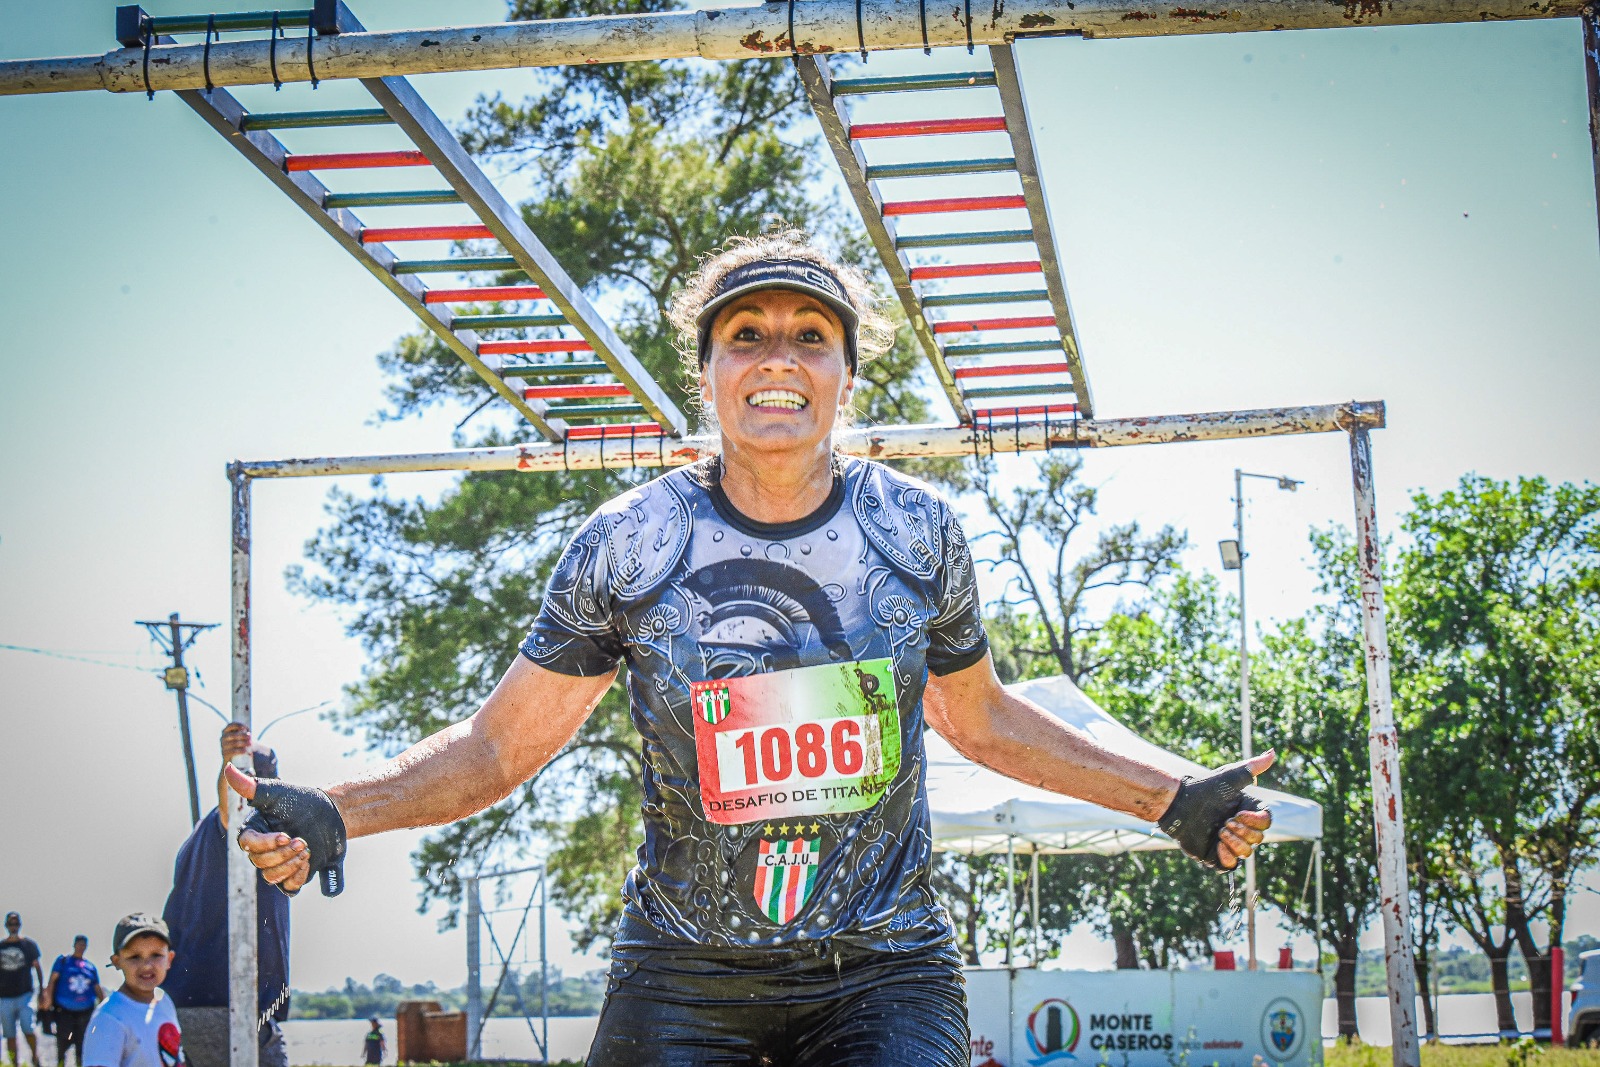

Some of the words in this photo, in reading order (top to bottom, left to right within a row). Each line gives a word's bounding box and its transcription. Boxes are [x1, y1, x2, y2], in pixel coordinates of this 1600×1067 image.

[735, 719, 864, 786] 1086
[709, 792, 788, 812] DESAFIO
[792, 788, 818, 802] DE
[764, 853, 813, 866] C.A.J.U.
[1090, 1013, 1153, 1031] MONTE
[1090, 1034, 1174, 1051] CASEROS
